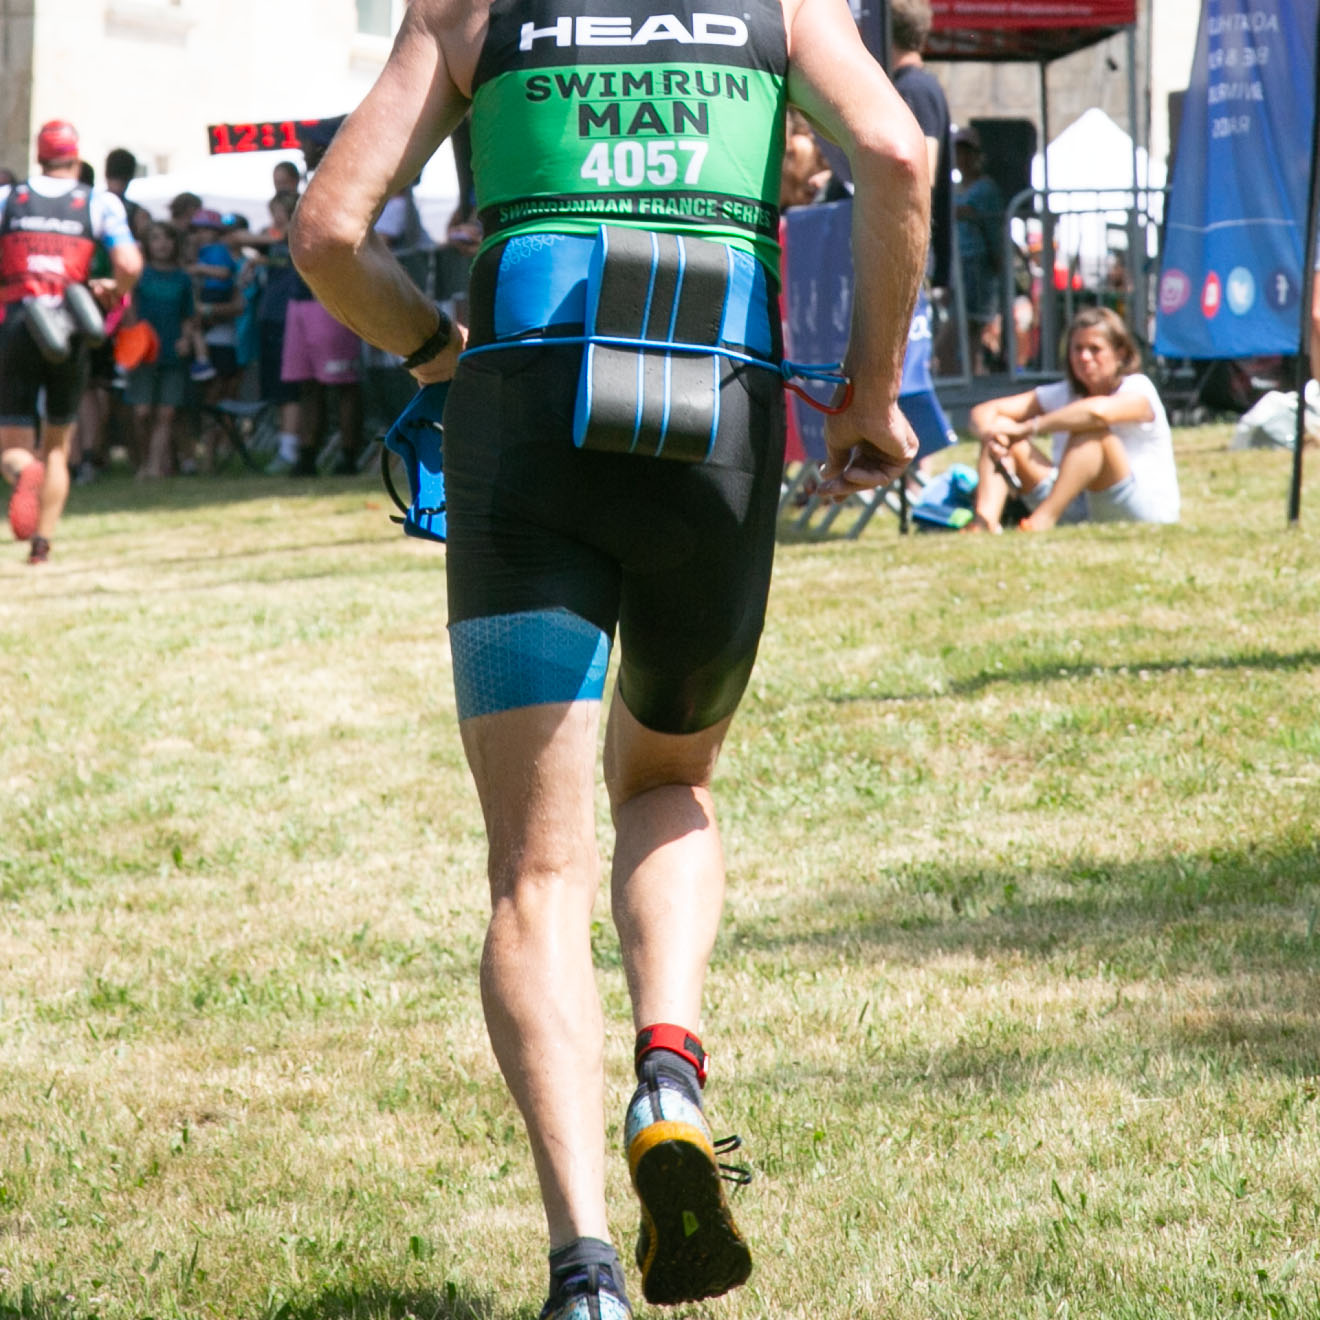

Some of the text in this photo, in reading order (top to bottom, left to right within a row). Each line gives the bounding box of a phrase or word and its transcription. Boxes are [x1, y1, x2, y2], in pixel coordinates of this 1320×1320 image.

[519, 12, 749, 52] HEAD
[525, 70, 749, 102] SWIMRUN
[578, 101, 710, 136] MAN
[212, 119, 321, 155] 12:1
[580, 140, 708, 187] 4057
[499, 199, 633, 224] SWIMRUNMAN
[638, 197, 717, 218] FRANCE
